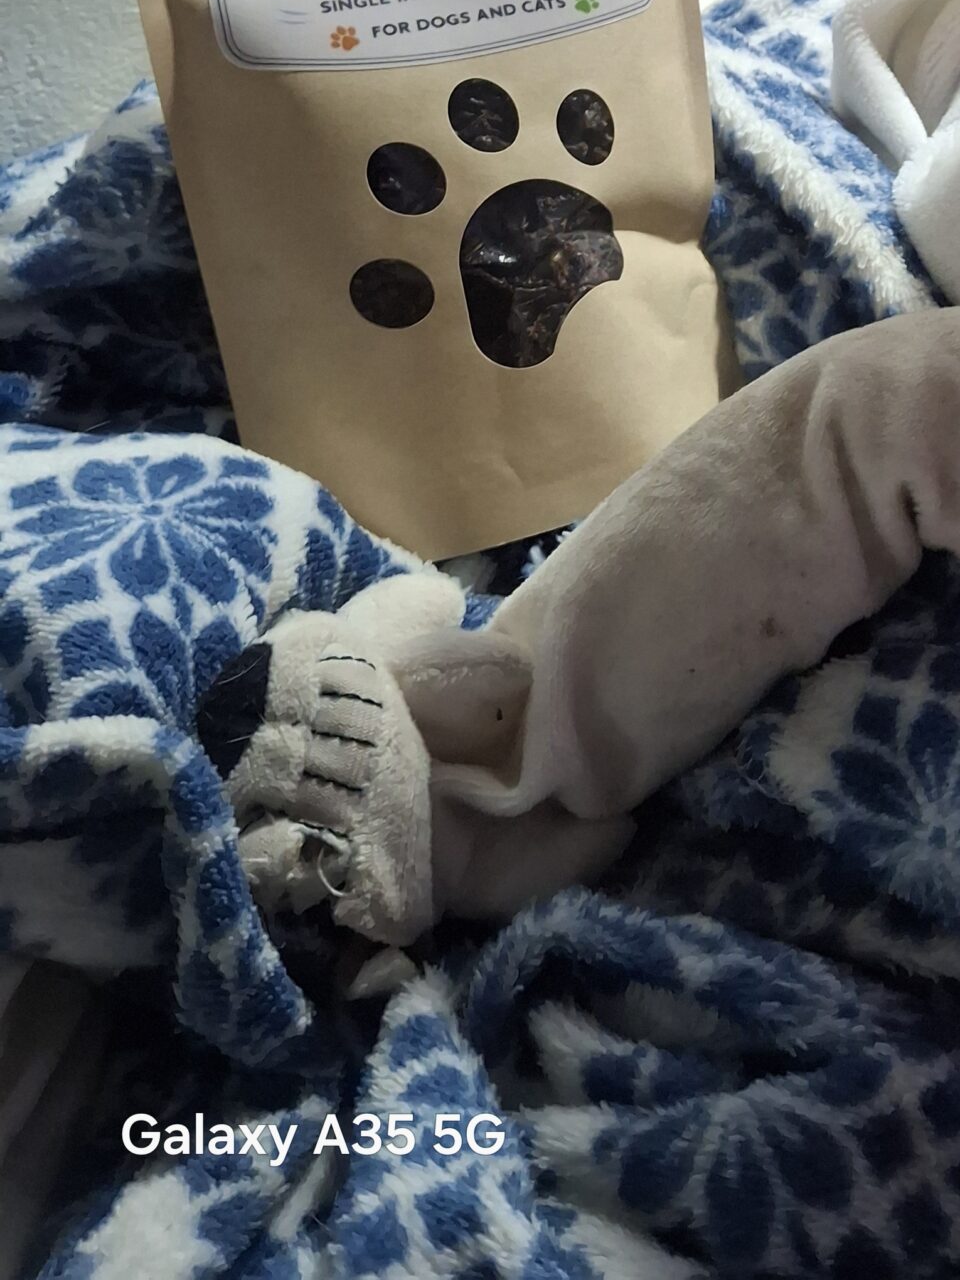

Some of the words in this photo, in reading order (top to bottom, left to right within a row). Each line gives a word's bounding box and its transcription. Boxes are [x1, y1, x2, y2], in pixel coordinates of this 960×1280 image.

[372, 22, 410, 39] FOR
[417, 11, 471, 32] DOGS
[477, 2, 517, 24] AND
